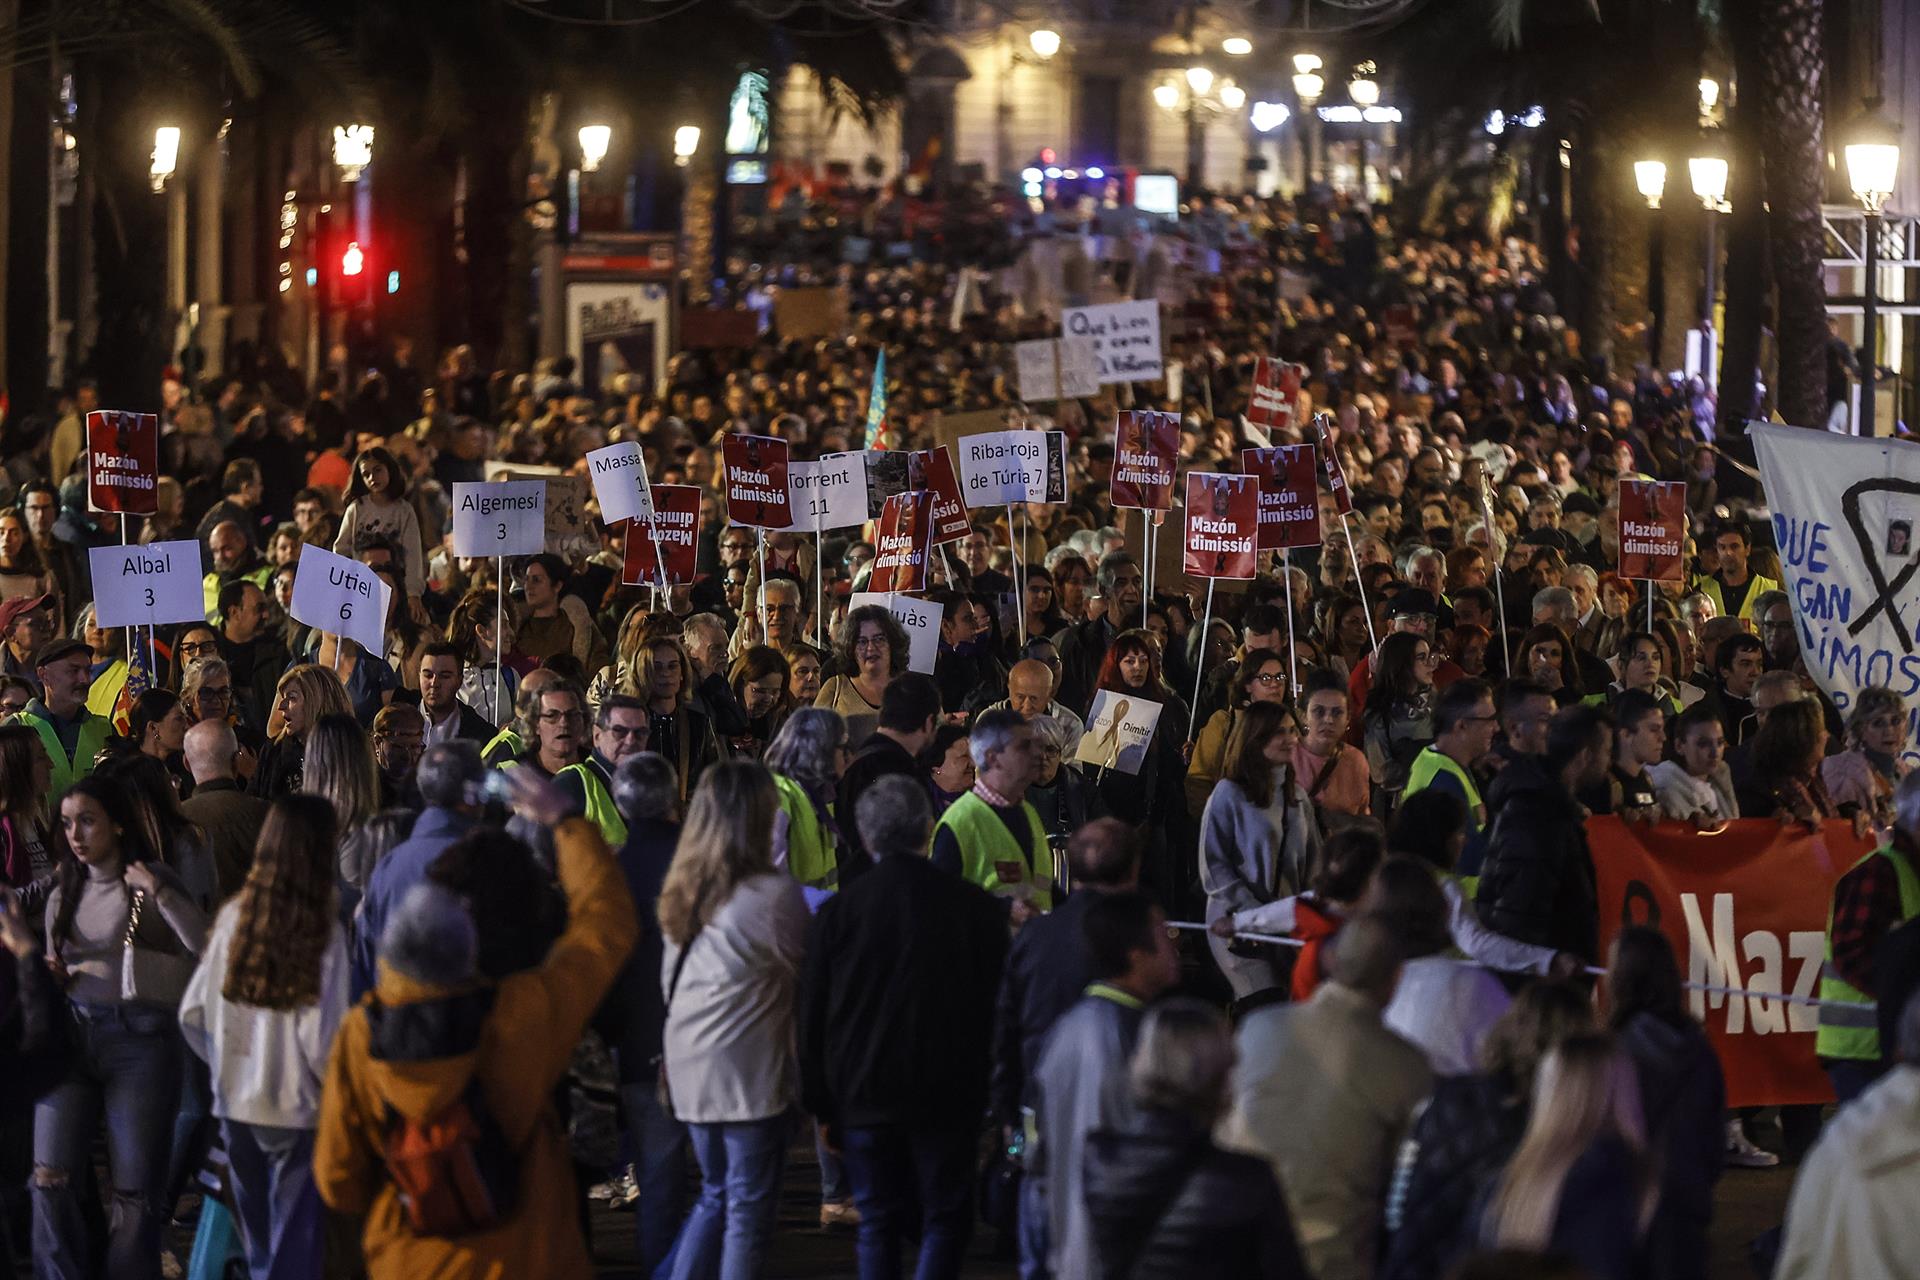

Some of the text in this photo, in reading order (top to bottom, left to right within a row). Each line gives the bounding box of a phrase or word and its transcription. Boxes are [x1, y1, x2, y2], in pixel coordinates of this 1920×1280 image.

[94, 452, 139, 470] Mazón
[971, 441, 1040, 462] Riba-roja
[1119, 450, 1159, 468] Mazón
[95, 470, 154, 490] dimissió
[730, 466, 770, 486] Mazón
[788, 469, 850, 489] Torrent
[970, 468, 1043, 490] de Túria 7
[1116, 468, 1171, 486] dimissió
[461, 491, 540, 516] Algemesí
[730, 484, 785, 505] dimissió
[808, 498, 830, 516] 11
[933, 499, 960, 519] ssió
[496, 522, 507, 541] 3
[1190, 516, 1237, 535] Mazón
[1623, 521, 1666, 538] Mazón
[880, 532, 913, 552] Mazón
[1190, 534, 1252, 553] dimissió
[1623, 538, 1679, 556] dimissió
[122, 553, 171, 577] Albal
[876, 548, 922, 569] dimissió
[328, 566, 372, 599] Utiel
[144, 588, 155, 607] 3
[1796, 577, 1850, 624] GAN
[339, 602, 353, 621] 6
[891, 608, 928, 628] uàs
